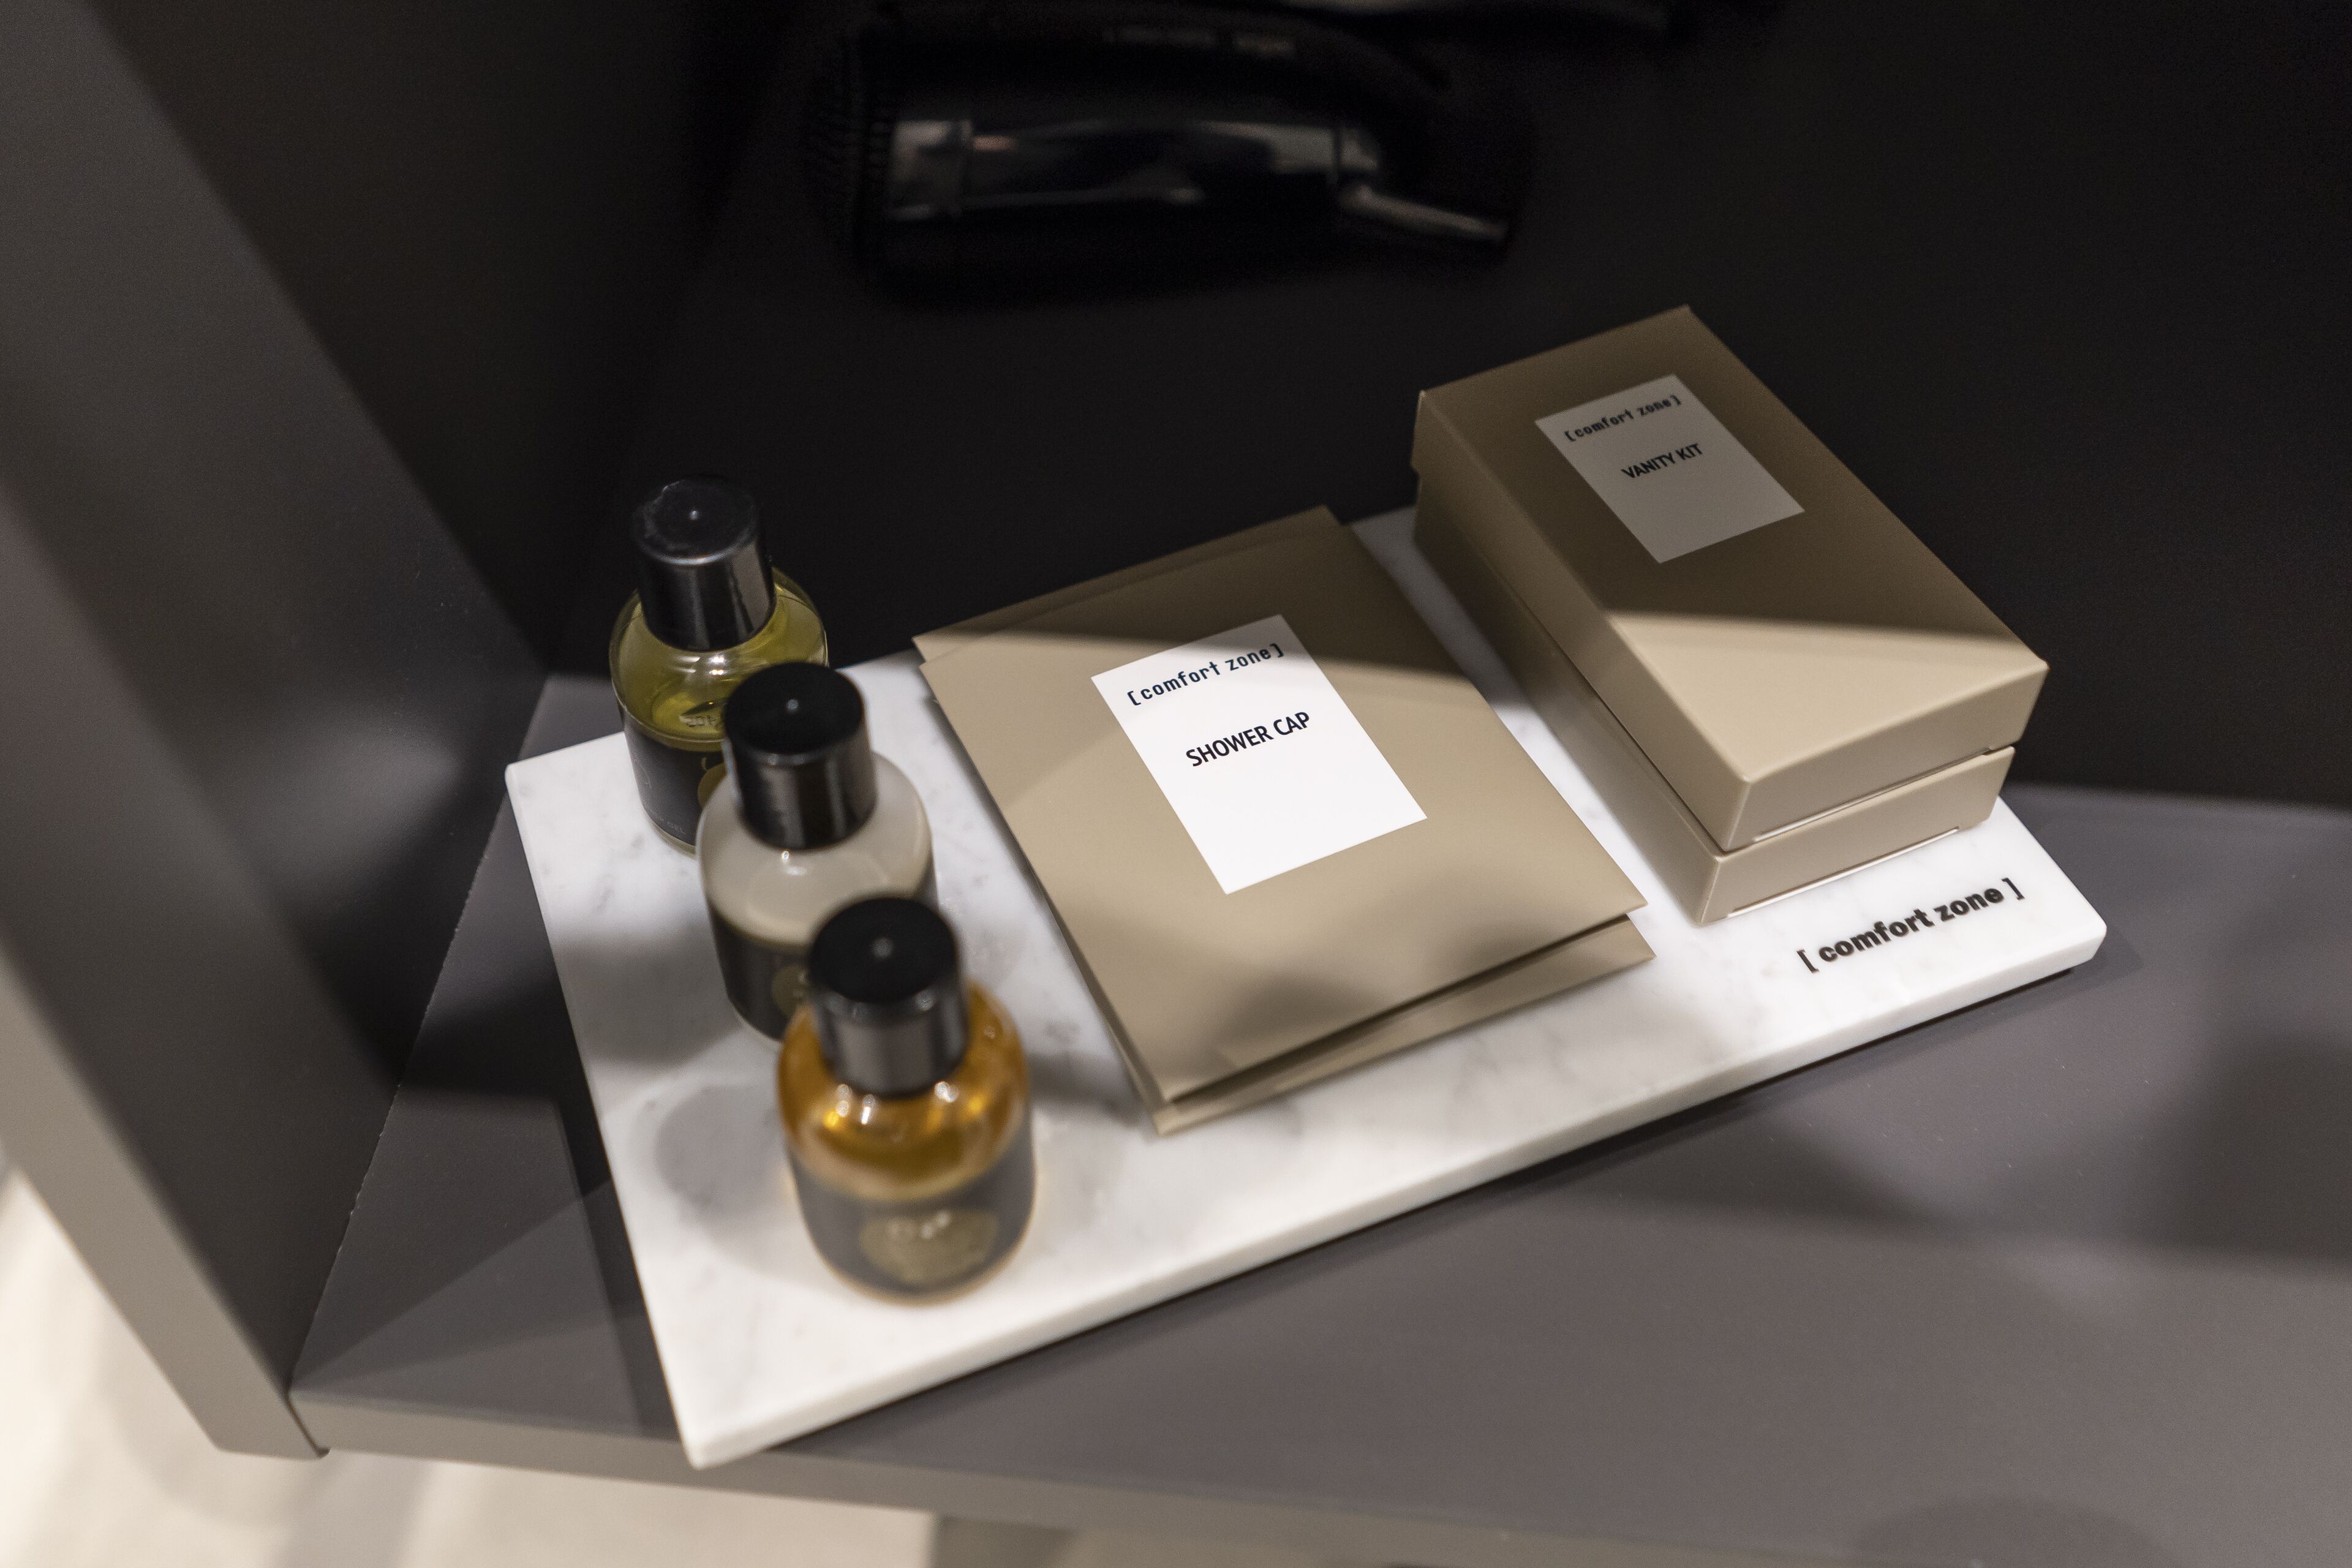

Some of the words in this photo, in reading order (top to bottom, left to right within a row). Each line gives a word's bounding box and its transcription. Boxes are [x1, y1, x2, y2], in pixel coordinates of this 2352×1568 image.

[1620, 451, 1676, 479] VANITY
[1675, 442, 1703, 461] KIT
[1185, 725, 1275, 767] SHOWER
[1273, 711, 1310, 736] CAP
